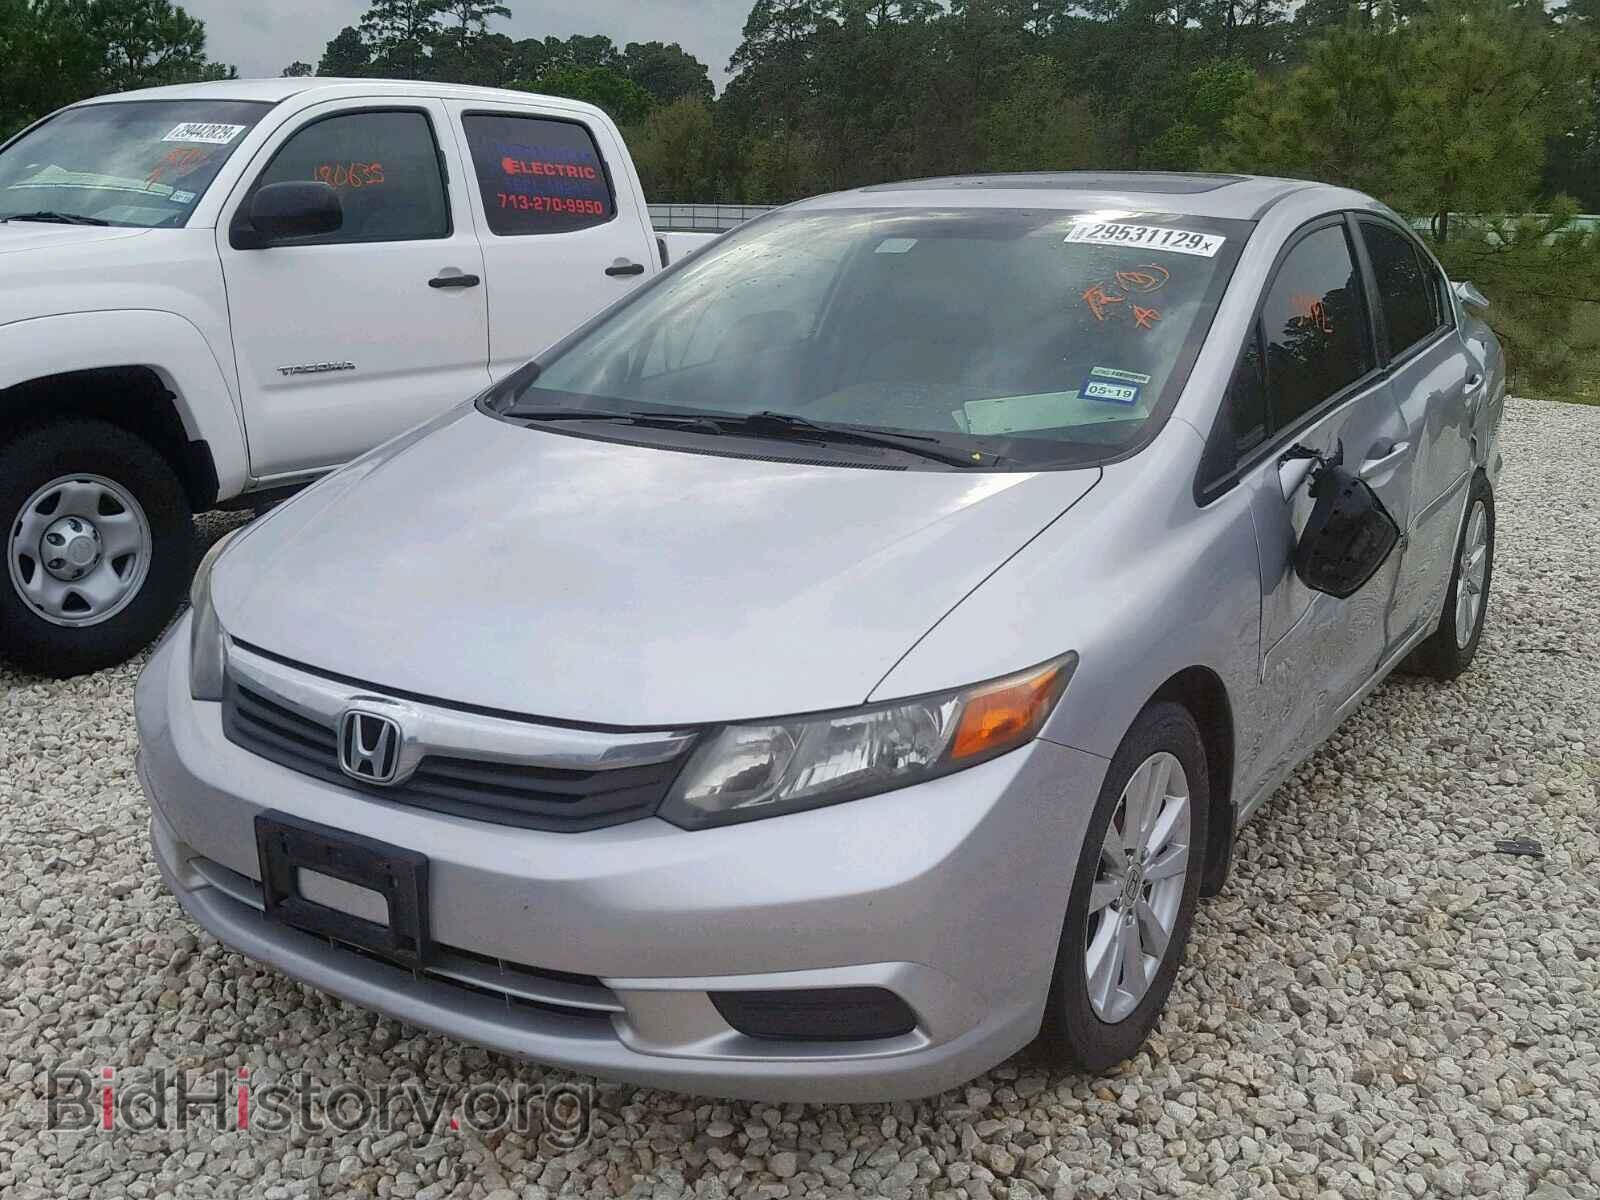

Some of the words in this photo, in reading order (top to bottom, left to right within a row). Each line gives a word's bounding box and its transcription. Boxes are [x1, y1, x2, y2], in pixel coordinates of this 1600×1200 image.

[508, 160, 597, 180] ELECTRIC
[497, 192, 604, 216] 713-270-9950
[276, 361, 356, 376] TACOMA
